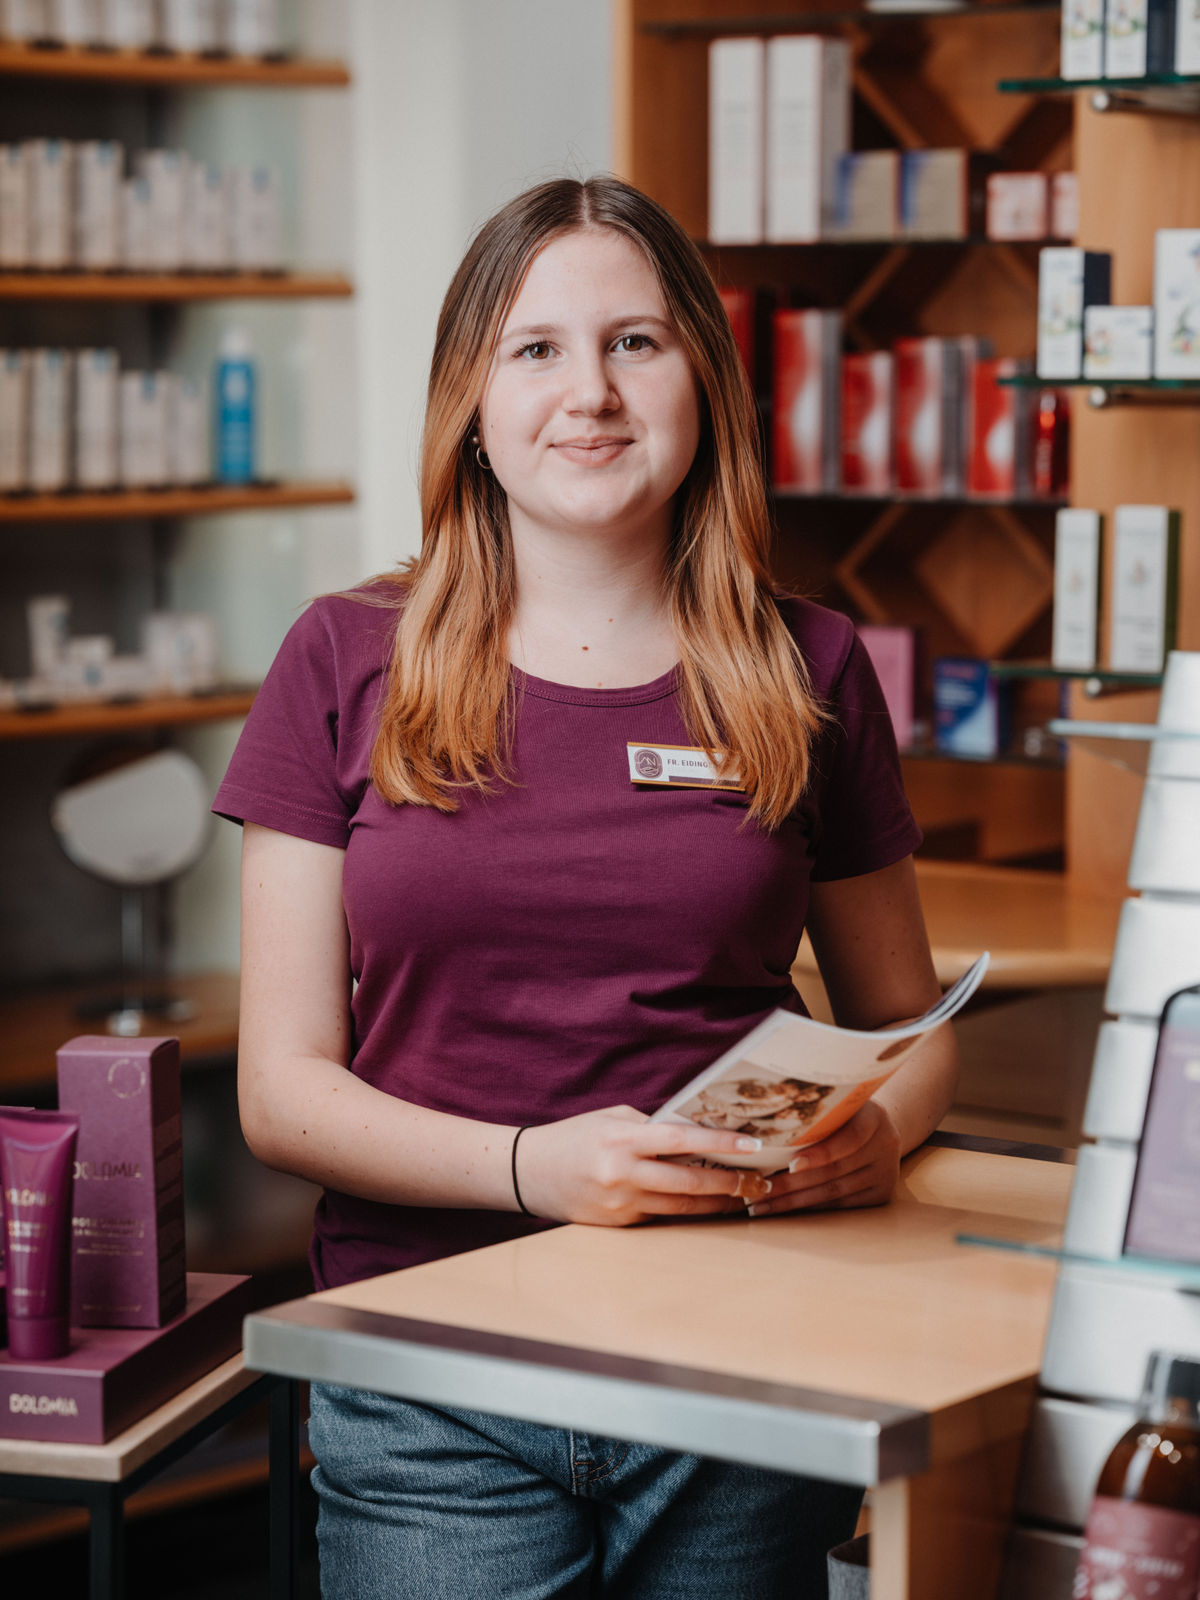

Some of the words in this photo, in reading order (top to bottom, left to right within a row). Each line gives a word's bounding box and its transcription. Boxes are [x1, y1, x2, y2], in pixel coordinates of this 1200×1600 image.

[667, 758, 680, 766] FR.
[681, 759, 710, 768] EIDING
[9, 1393, 79, 1418] DOLOMIA
